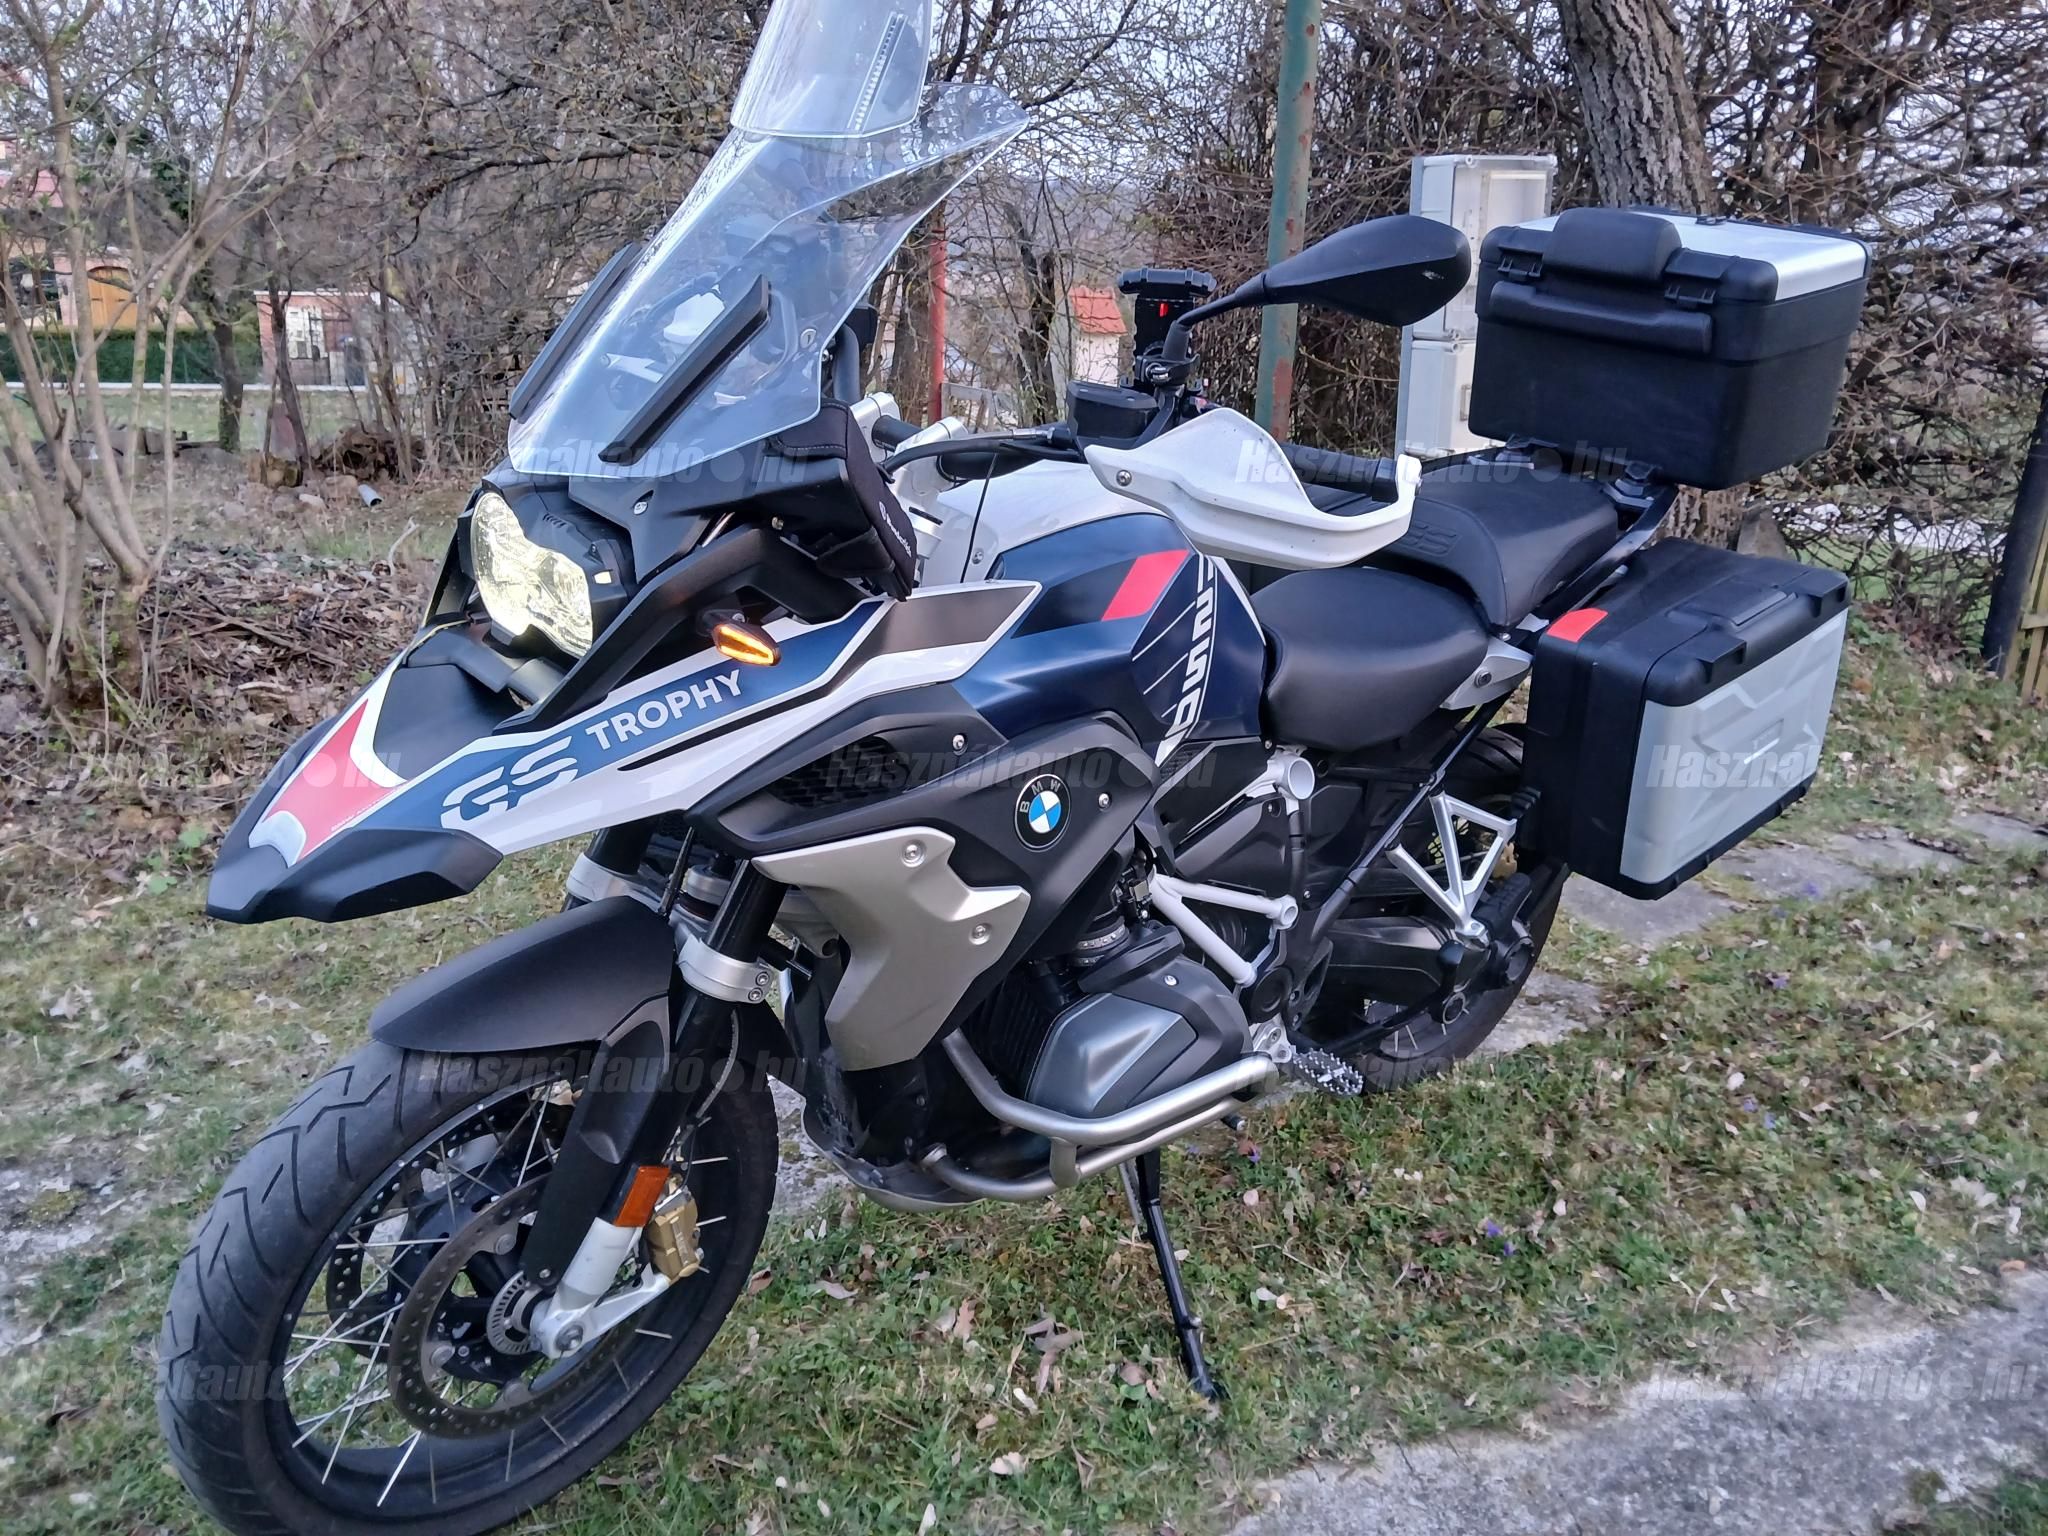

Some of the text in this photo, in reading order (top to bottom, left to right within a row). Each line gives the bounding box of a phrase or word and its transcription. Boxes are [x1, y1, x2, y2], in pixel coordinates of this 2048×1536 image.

[440, 735, 579, 829] GS
[584, 668, 743, 751] TROPHY
[1019, 778, 1061, 813] BMW
